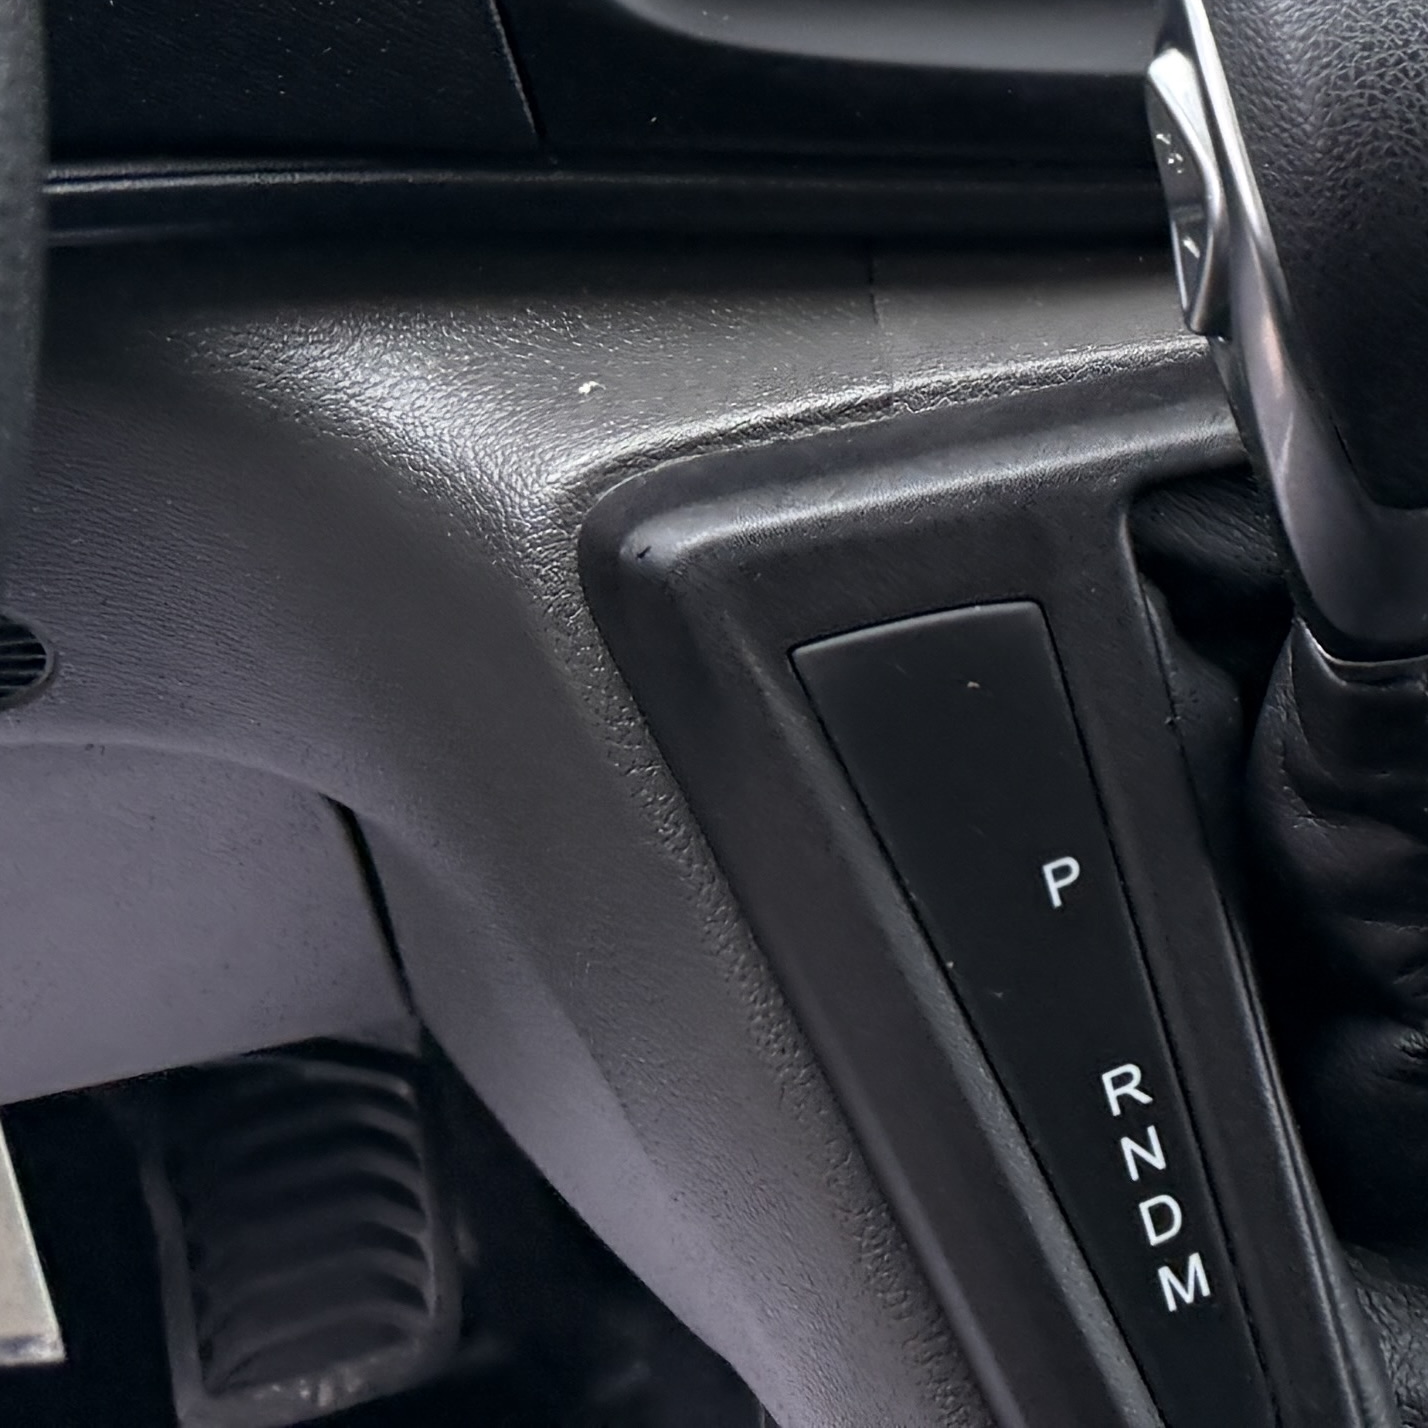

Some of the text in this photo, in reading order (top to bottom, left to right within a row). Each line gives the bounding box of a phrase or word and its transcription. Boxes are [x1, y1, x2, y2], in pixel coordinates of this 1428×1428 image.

[1042, 856, 1081, 908] P
[1101, 1063, 1153, 1117] R
[1120, 1125, 1167, 1182] N
[1138, 1194, 1183, 1247] D
[1157, 1252, 1211, 1312] M
